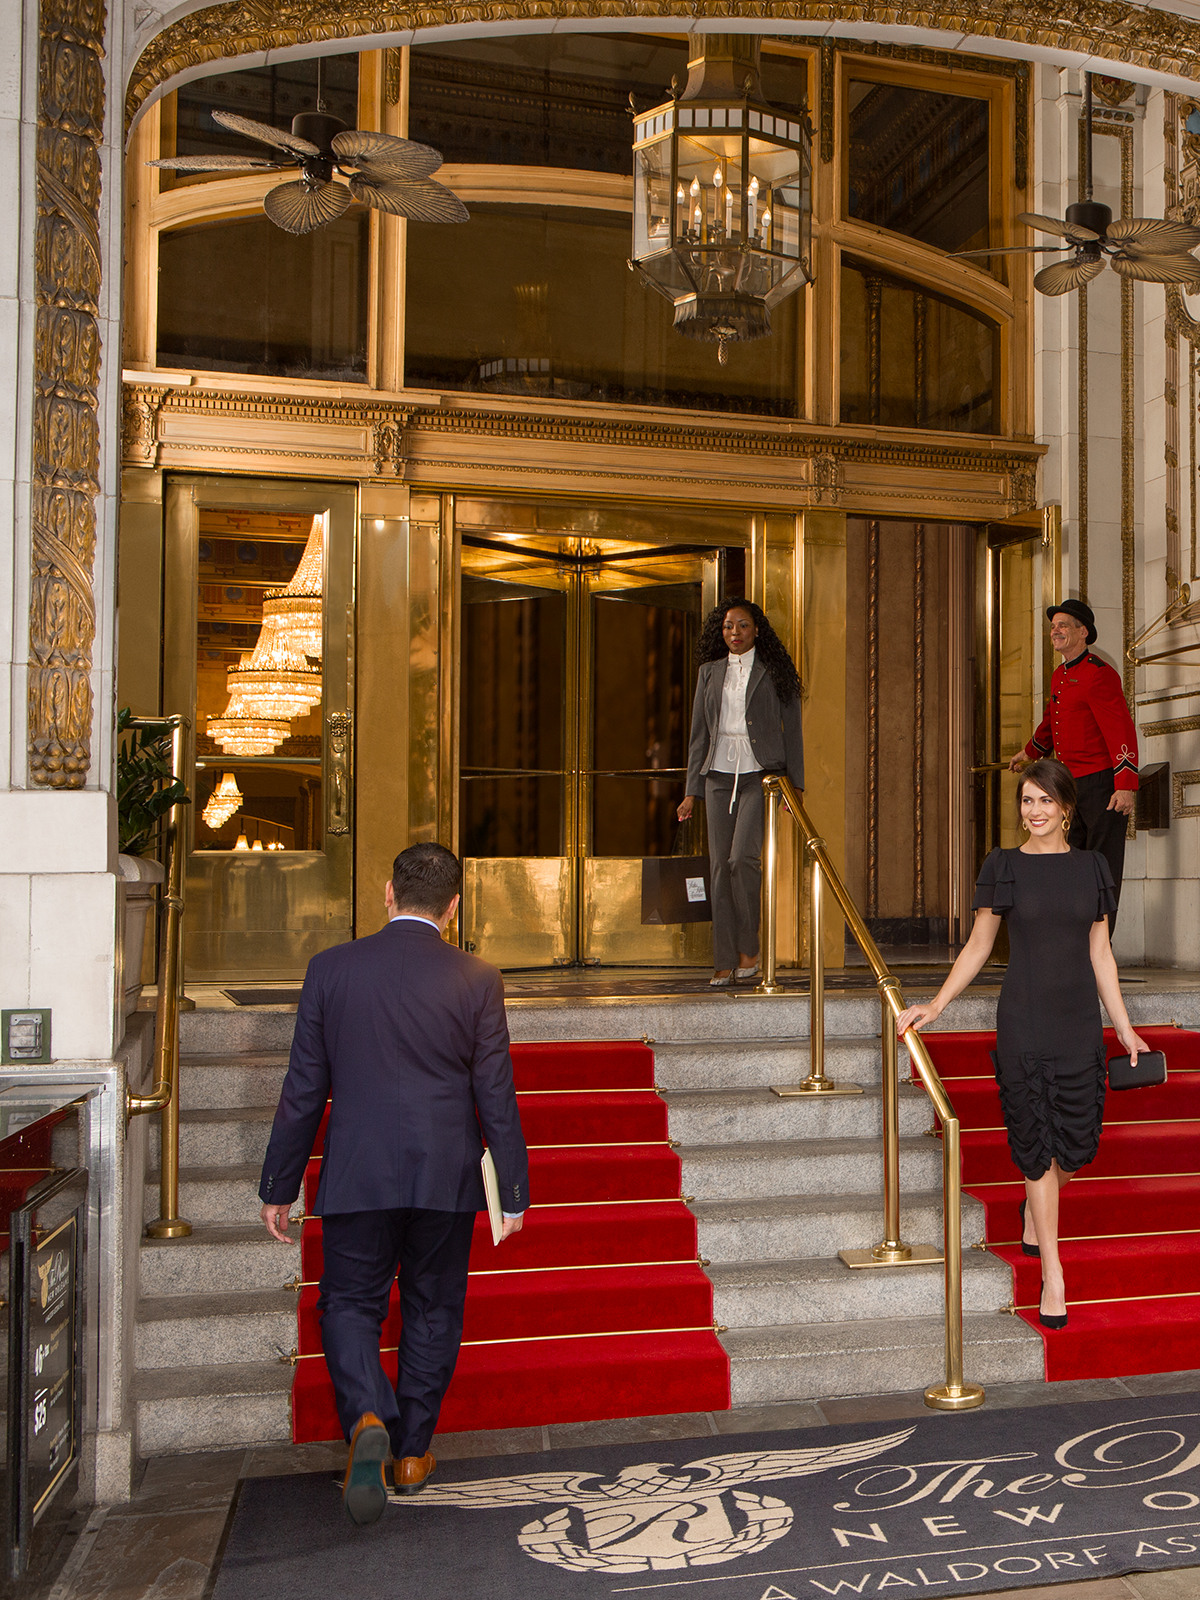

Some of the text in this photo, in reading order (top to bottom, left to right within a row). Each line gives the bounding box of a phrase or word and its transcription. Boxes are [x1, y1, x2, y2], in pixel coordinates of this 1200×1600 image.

[833, 1452, 1060, 1513] The
[831, 1503, 1064, 1548] NEW
[759, 1585, 797, 1600] A
[809, 1545, 1108, 1596] WALDORF
